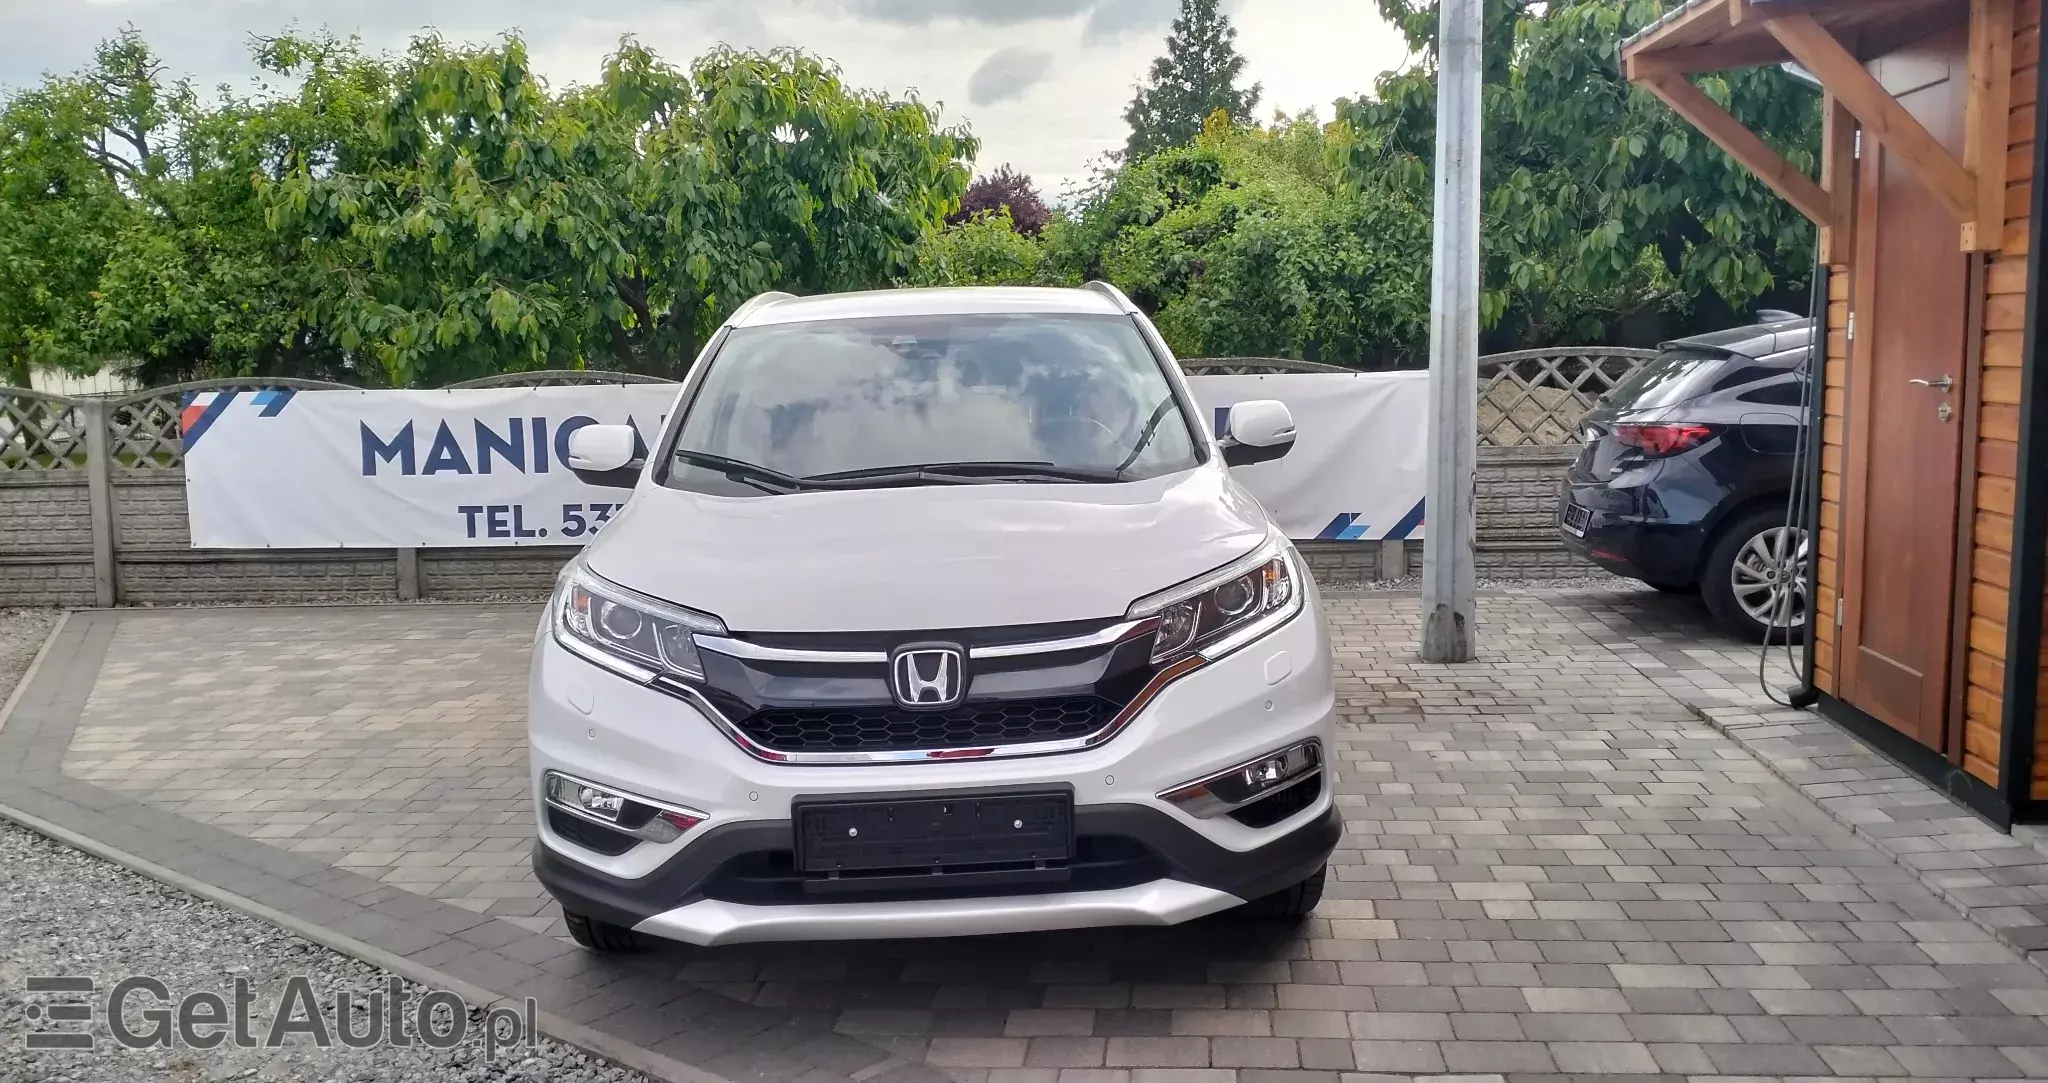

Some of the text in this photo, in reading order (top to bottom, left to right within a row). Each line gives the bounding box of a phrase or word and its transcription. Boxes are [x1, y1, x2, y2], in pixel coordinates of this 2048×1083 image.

[360, 414, 666, 476] MANICA
[457, 503, 625, 538] TEL. 53
